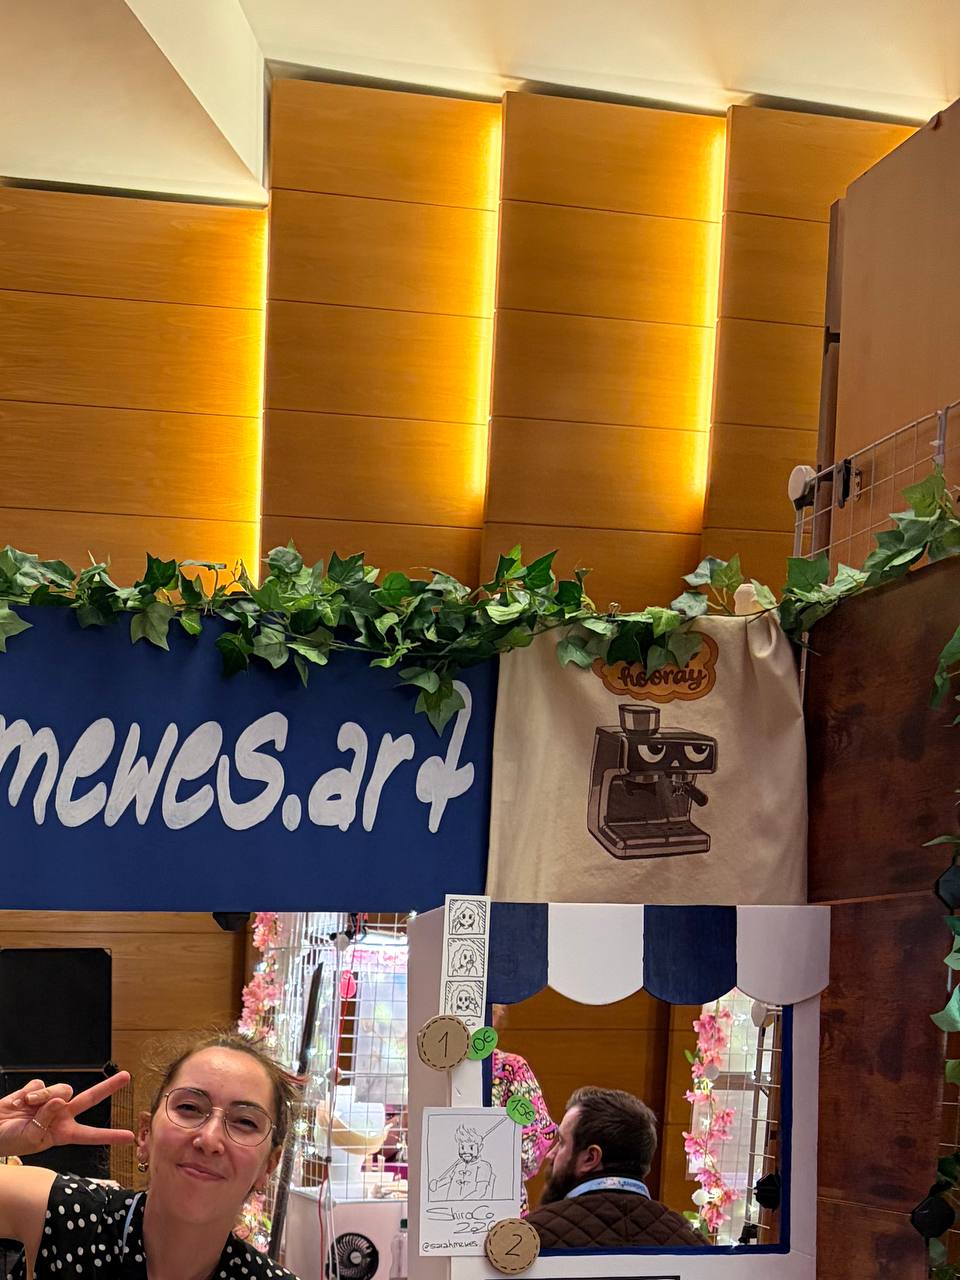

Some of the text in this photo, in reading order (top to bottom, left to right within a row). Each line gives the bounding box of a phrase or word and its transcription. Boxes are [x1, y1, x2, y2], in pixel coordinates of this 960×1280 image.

[438, 1031, 449, 1058] 1
[471, 1030, 494, 1054] 10€
[511, 1099, 535, 1121] 15€
[504, 1233, 523, 1257] 2
